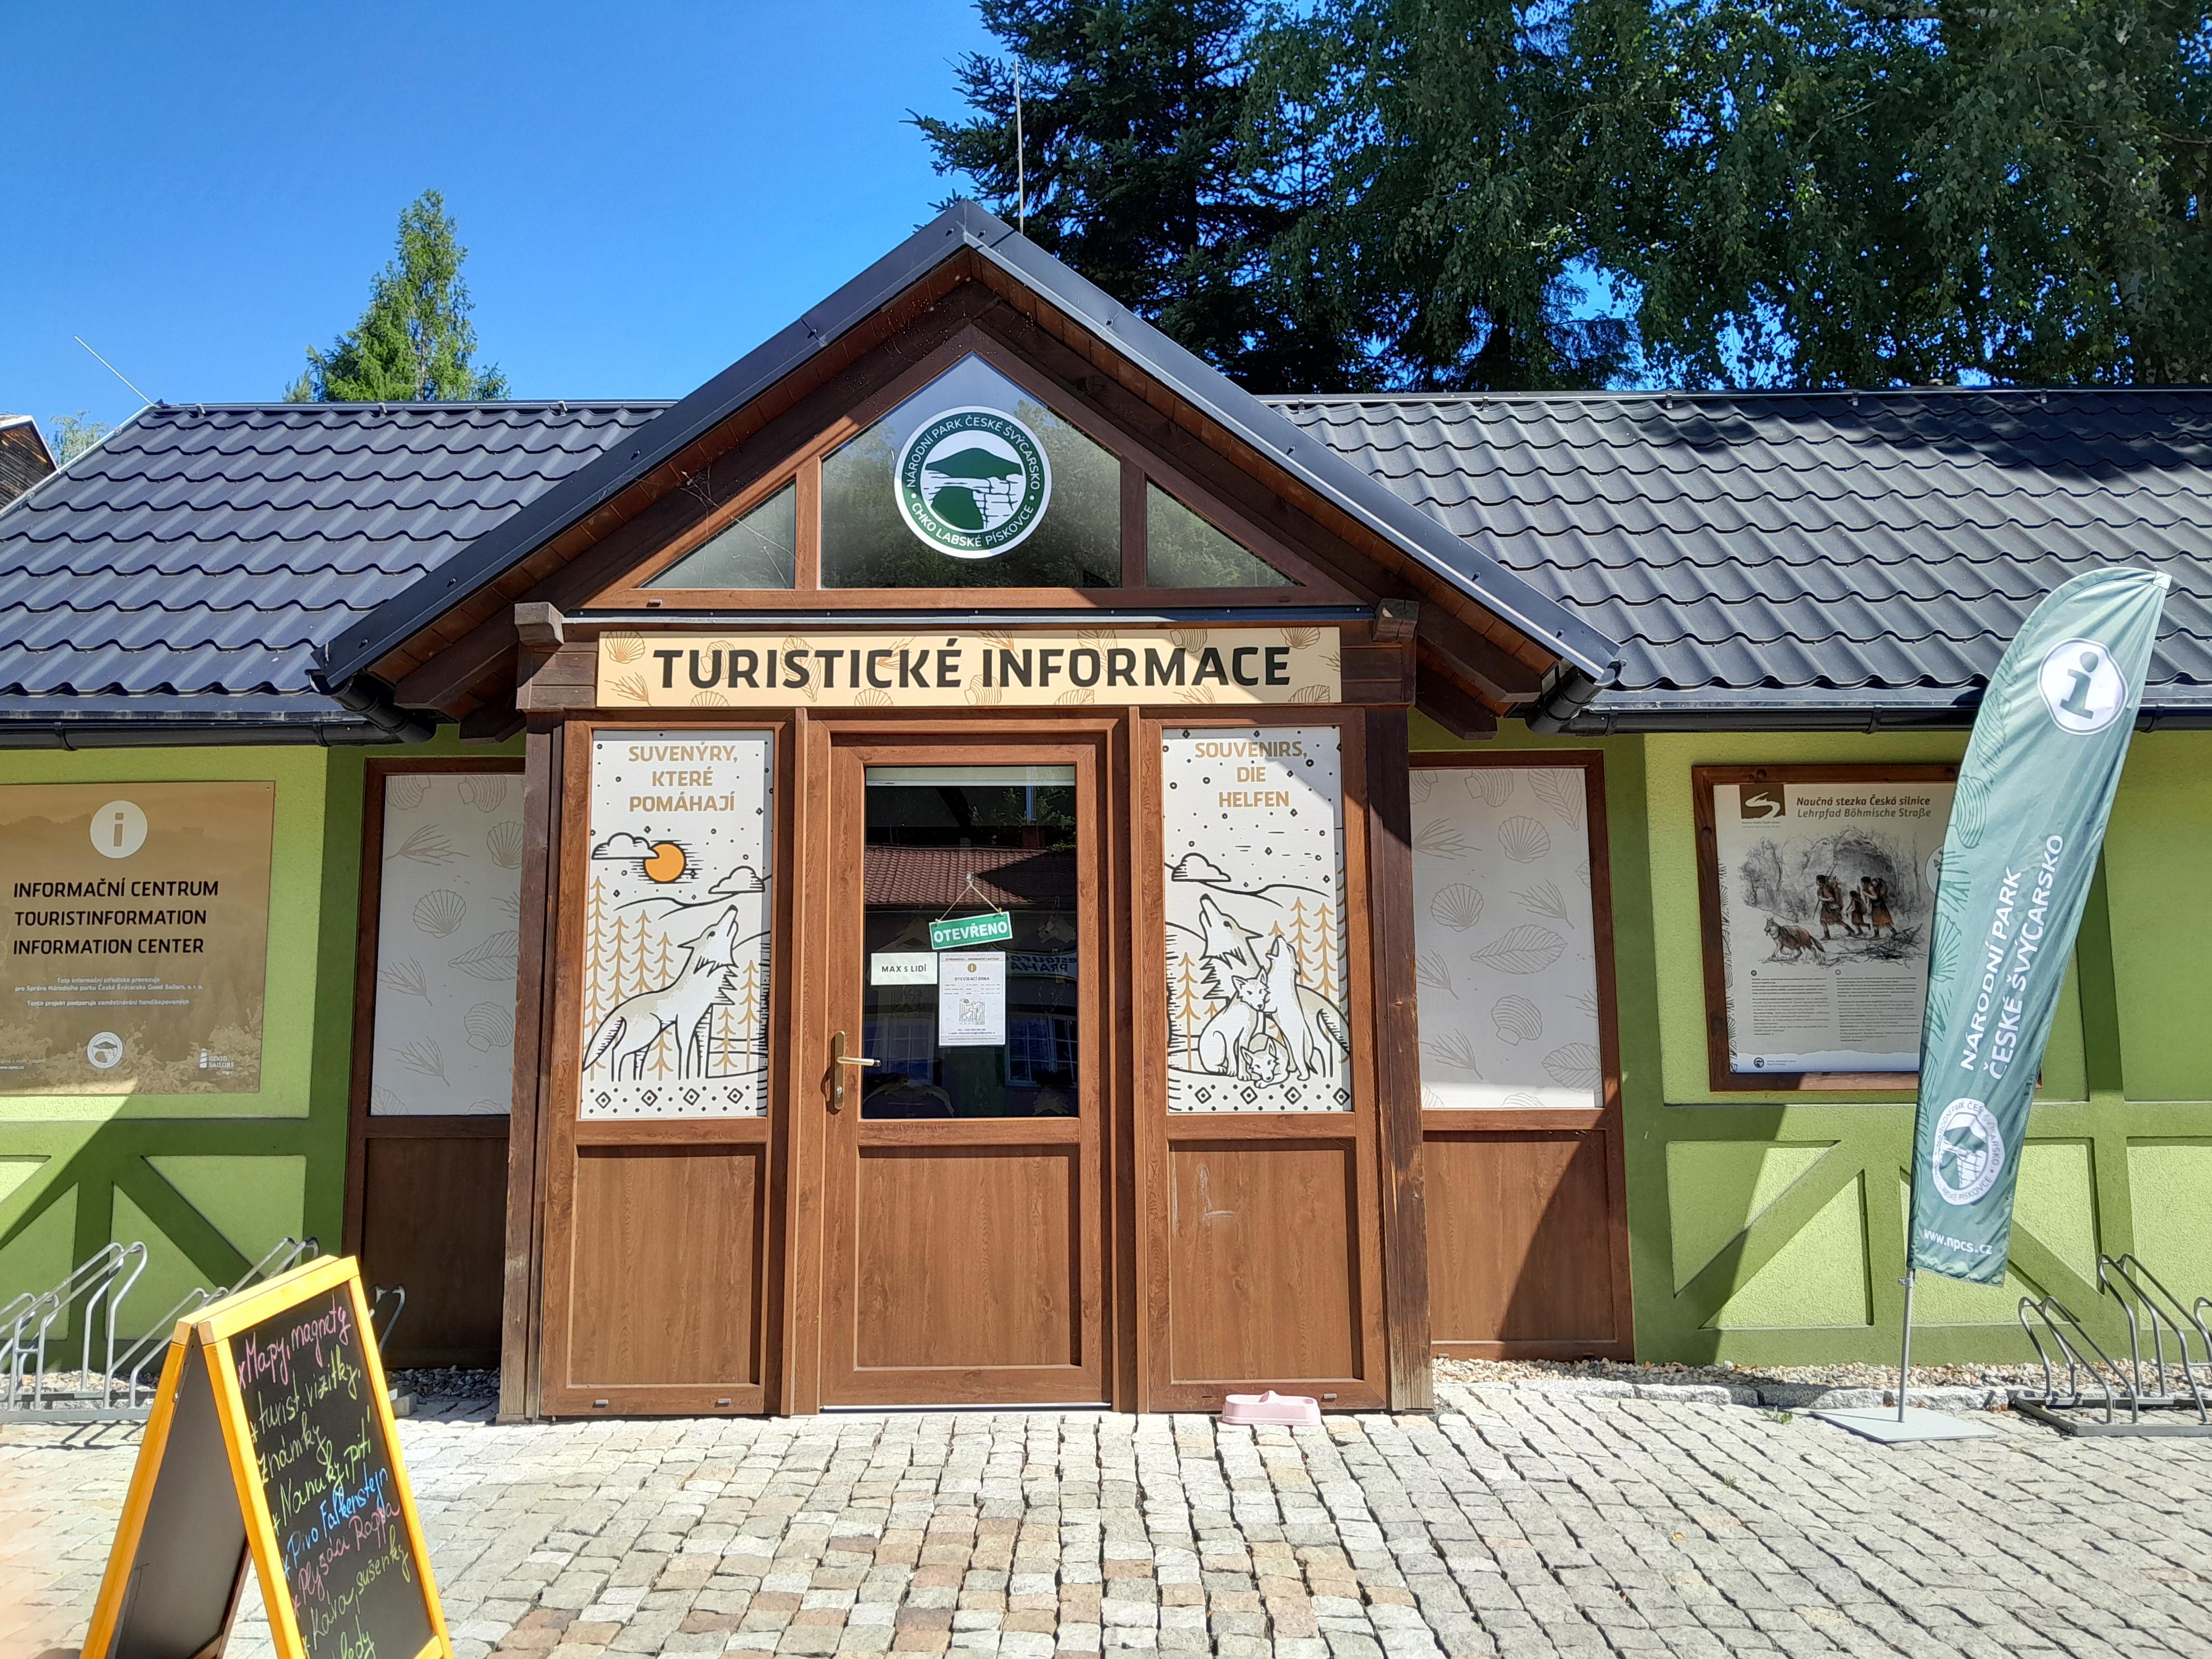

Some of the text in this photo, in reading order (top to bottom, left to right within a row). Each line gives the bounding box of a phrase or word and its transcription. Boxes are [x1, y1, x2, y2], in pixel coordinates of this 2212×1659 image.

[905, 415, 1040, 491] NÁRODNÍ PARK ČESKÉ ŠVÝCARSKO
[912, 502, 1034, 547] CHKO LABSKÉ PÍSKOVCE
[653, 638, 1291, 688] TURISTICKÉ INFORMACE
[628, 742, 738, 763] SUVENÝRY,
[1194, 740, 1307, 759] SOUVENIRS,
[651, 766, 714, 786] KTERÉ
[1237, 766, 1266, 782] DIE
[629, 791, 735, 812] POMÁHAJÍ
[1218, 791, 1290, 808] HELFEN
[1797, 794, 1931, 806] Naučná stezka Česká silnice
[1797, 807, 1932, 820] Lehrpfad Böhmische Straße
[13, 877, 219, 898] INFORMAČNÍ CENTRUM
[14, 910, 207, 926] TOURISTINFORMATION
[933, 921, 1008, 943] OTEVŘENO
[13, 938, 205, 955] INFORMATION CENTER
[911, 963, 926, 972] LIDÍ
[1982, 834, 2064, 1081] ČESKÉ ŠVÝCARSKO
[1960, 866, 2022, 1072] NÁRODNÍ PARK
[1923, 1227, 1993, 1255] www.npcs.cz
[287, 1527, 319, 1569] Pivo
